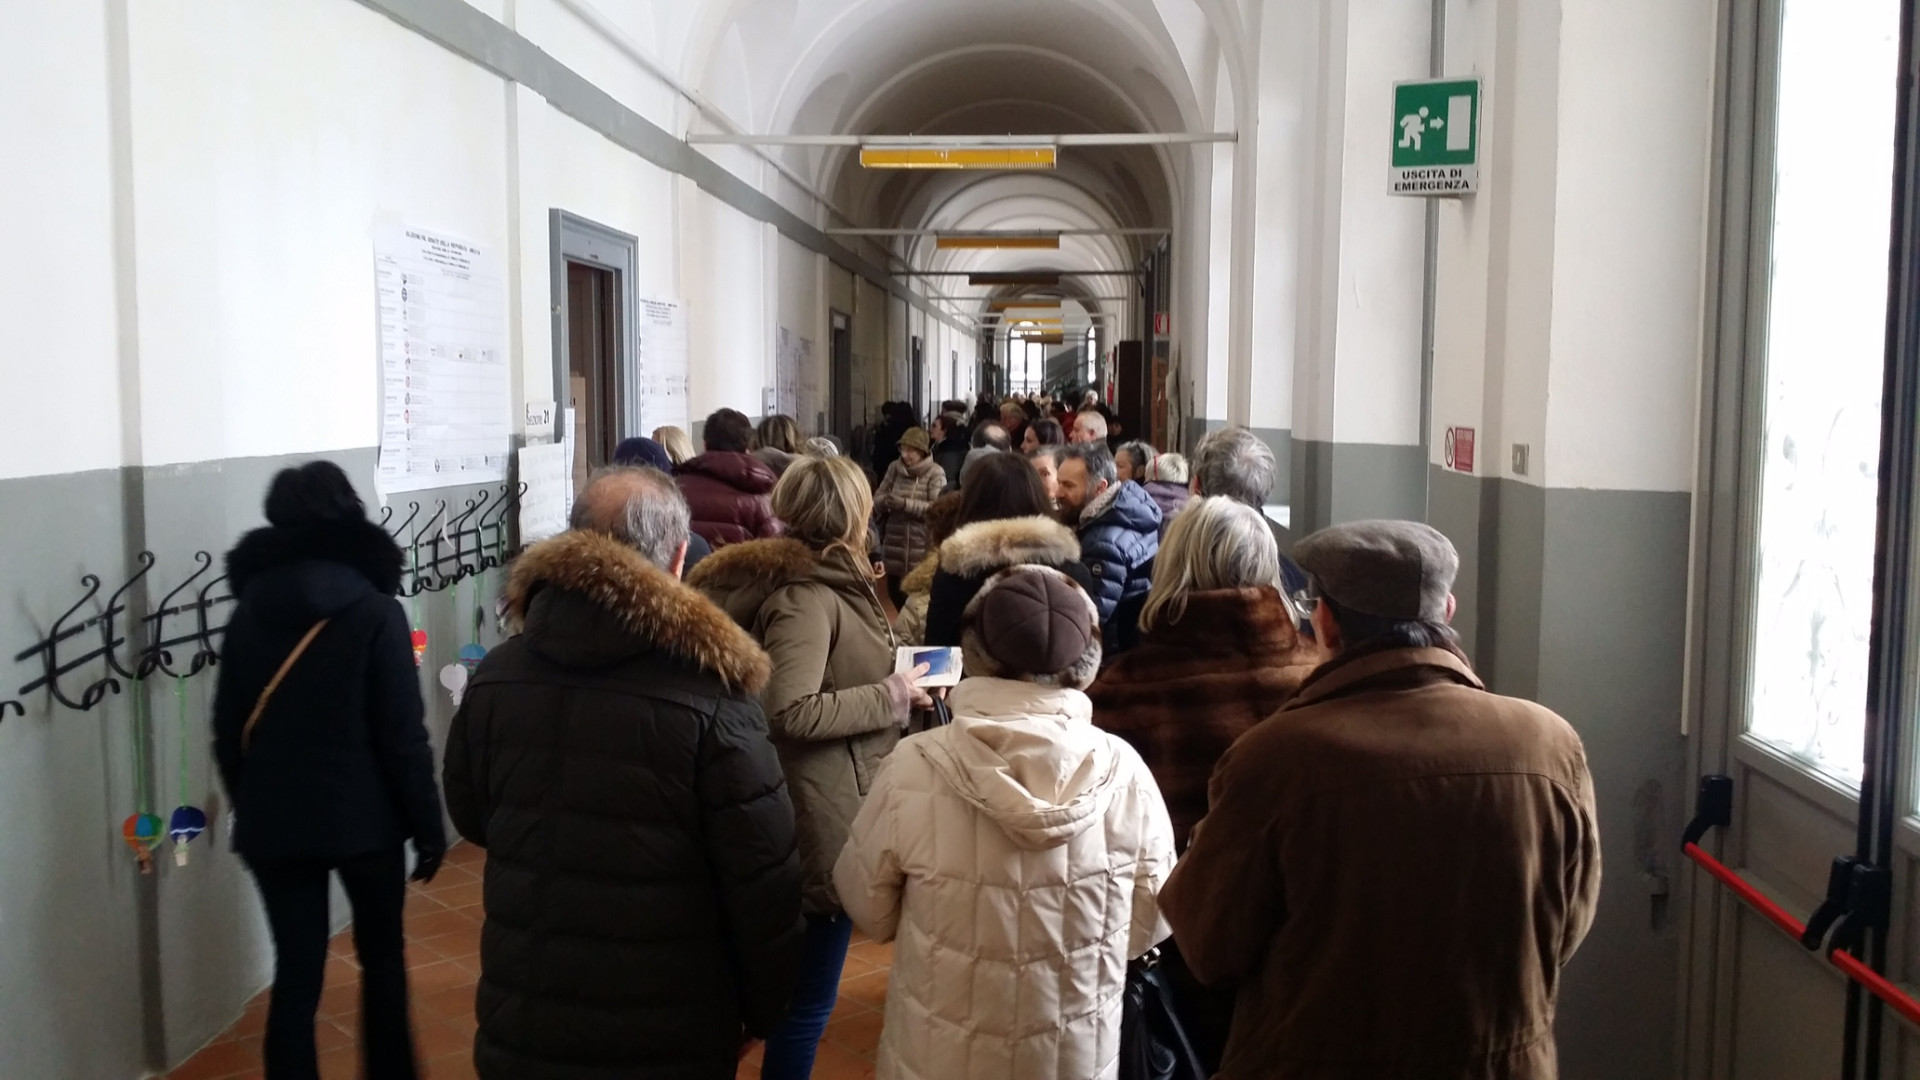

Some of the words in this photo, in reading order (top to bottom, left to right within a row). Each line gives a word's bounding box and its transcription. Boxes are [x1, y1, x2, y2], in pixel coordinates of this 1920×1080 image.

[1402, 169, 1446, 179] USCITA
[1450, 168, 1462, 178] DI
[1394, 181, 1469, 191] EMERGENZA
[543, 409, 550, 424] 21
